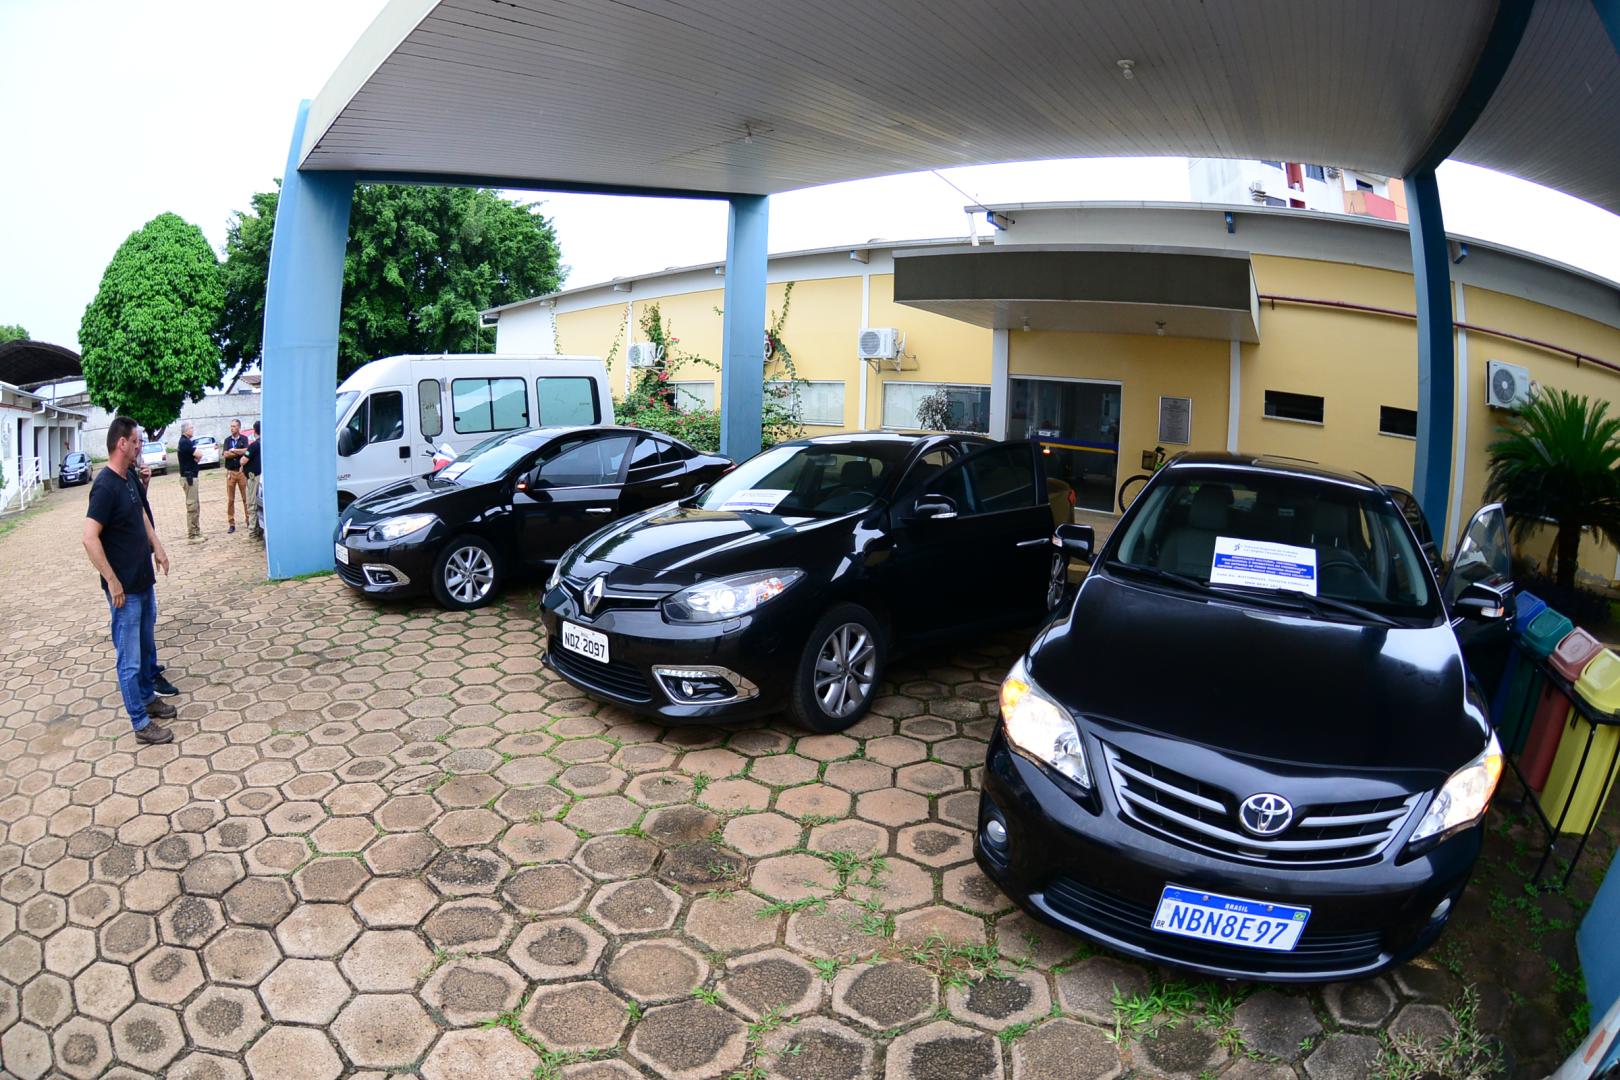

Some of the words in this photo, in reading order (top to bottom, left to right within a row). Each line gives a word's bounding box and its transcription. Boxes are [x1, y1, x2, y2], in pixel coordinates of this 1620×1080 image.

[583, 638, 605, 659] 2097
[1225, 903, 1248, 913] BRASIL
[1155, 919, 1165, 928] BR
[1168, 905, 1289, 945] NBN8E97
